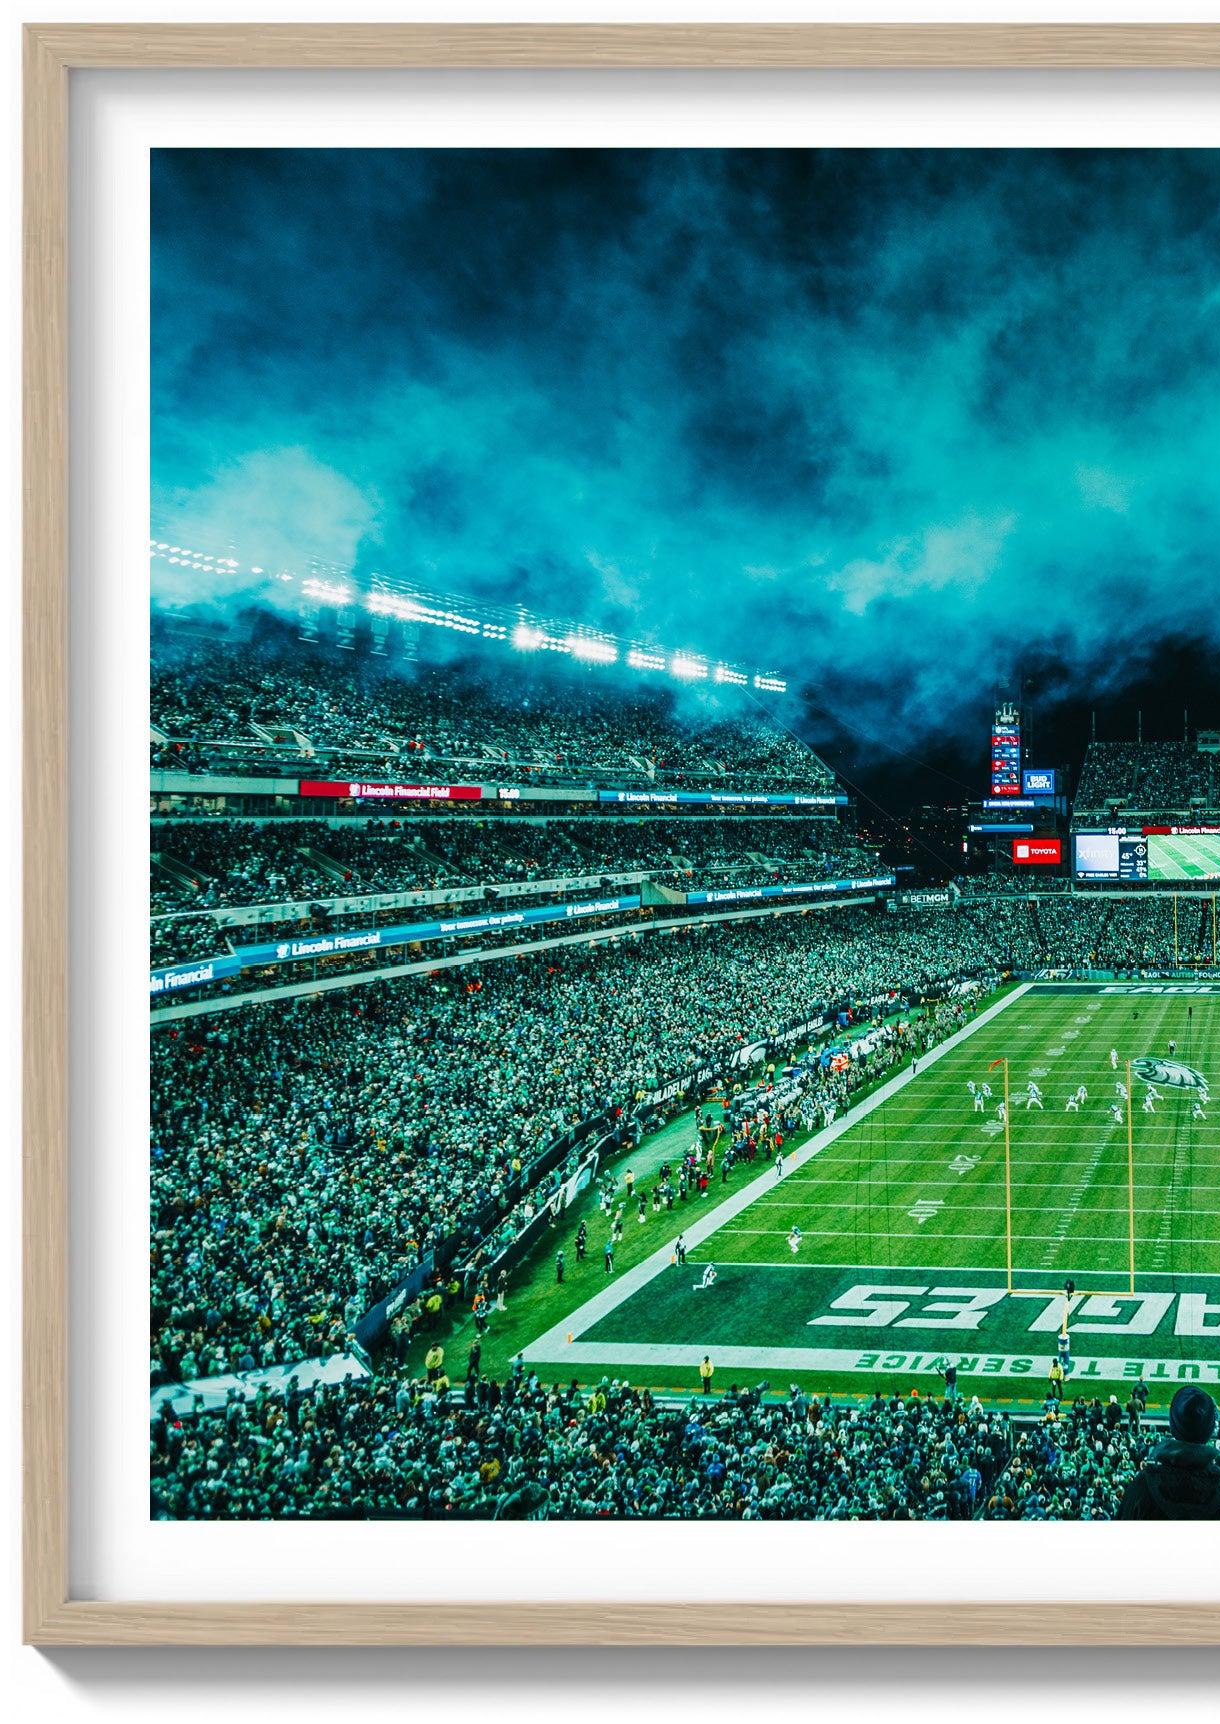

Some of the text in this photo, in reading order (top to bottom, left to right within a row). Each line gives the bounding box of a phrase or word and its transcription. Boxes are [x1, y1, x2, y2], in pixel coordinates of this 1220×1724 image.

[1027, 781, 1051, 789] LIGHT
[1030, 775, 1048, 783] BUD
[362, 785, 450, 798] Lincoln Financial Field
[626, 793, 678, 802] Lincoln Financial
[1107, 827, 1127, 835] 15:00
[856, 877, 891, 888] Lincoln Financial
[714, 889, 762, 901] Lincoln Financial
[910, 893, 949, 903] BETMGM
[573, 899, 619, 915] Lincoln Financial
[489, 916, 501, 926] Our
[292, 931, 381, 956] Lincoln Financial
[164, 964, 214, 989] Financial
[948, 1154, 982, 1170] 20
[907, 1198, 945, 1218] 10
[854, 1353, 1033, 1373] SERVICE
